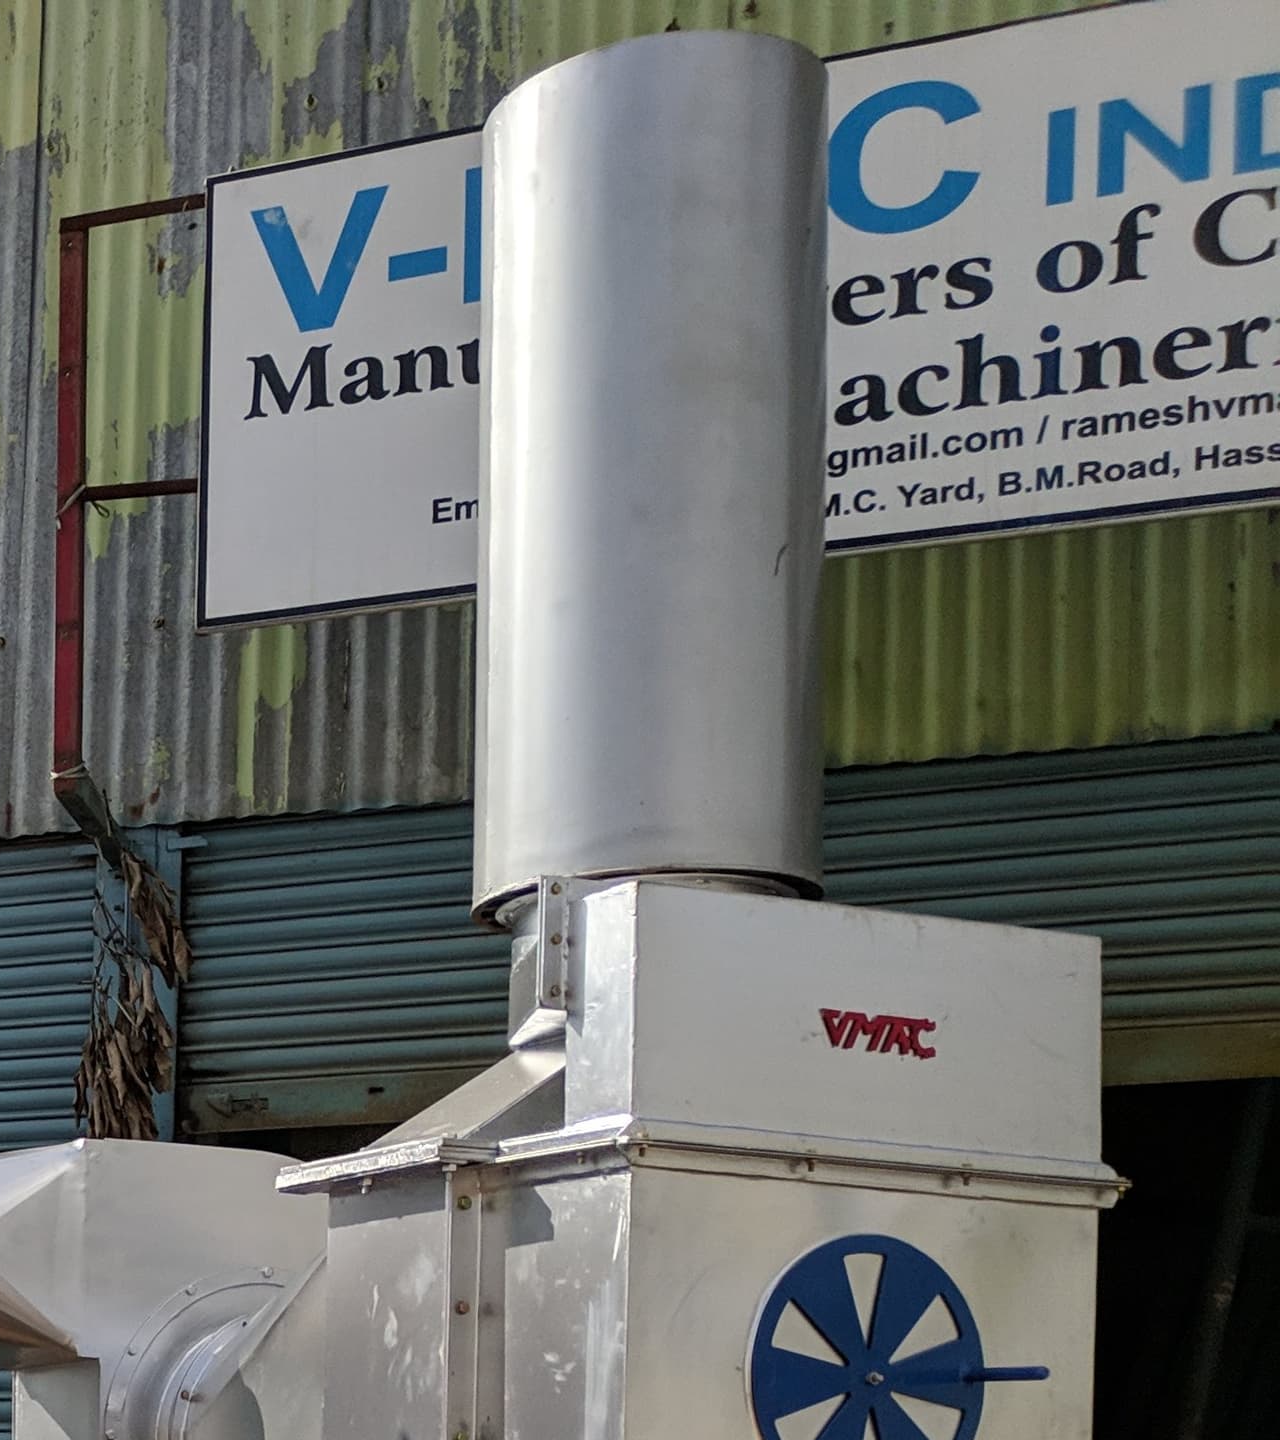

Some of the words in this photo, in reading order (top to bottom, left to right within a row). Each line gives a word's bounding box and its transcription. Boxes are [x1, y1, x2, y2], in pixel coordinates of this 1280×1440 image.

[250, 166, 481, 332] V-
[826, 257, 992, 326] ers
[1036, 203, 1162, 293] of
[834, 316, 1280, 426] achiner
[827, 426, 1023, 478] gmail.com
[1061, 392, 1280, 440] rameshvm
[897, 477, 984, 508] Yard,
[998, 451, 1180, 497] B.M.Road,
[819, 1008, 936, 1060] VMAC
